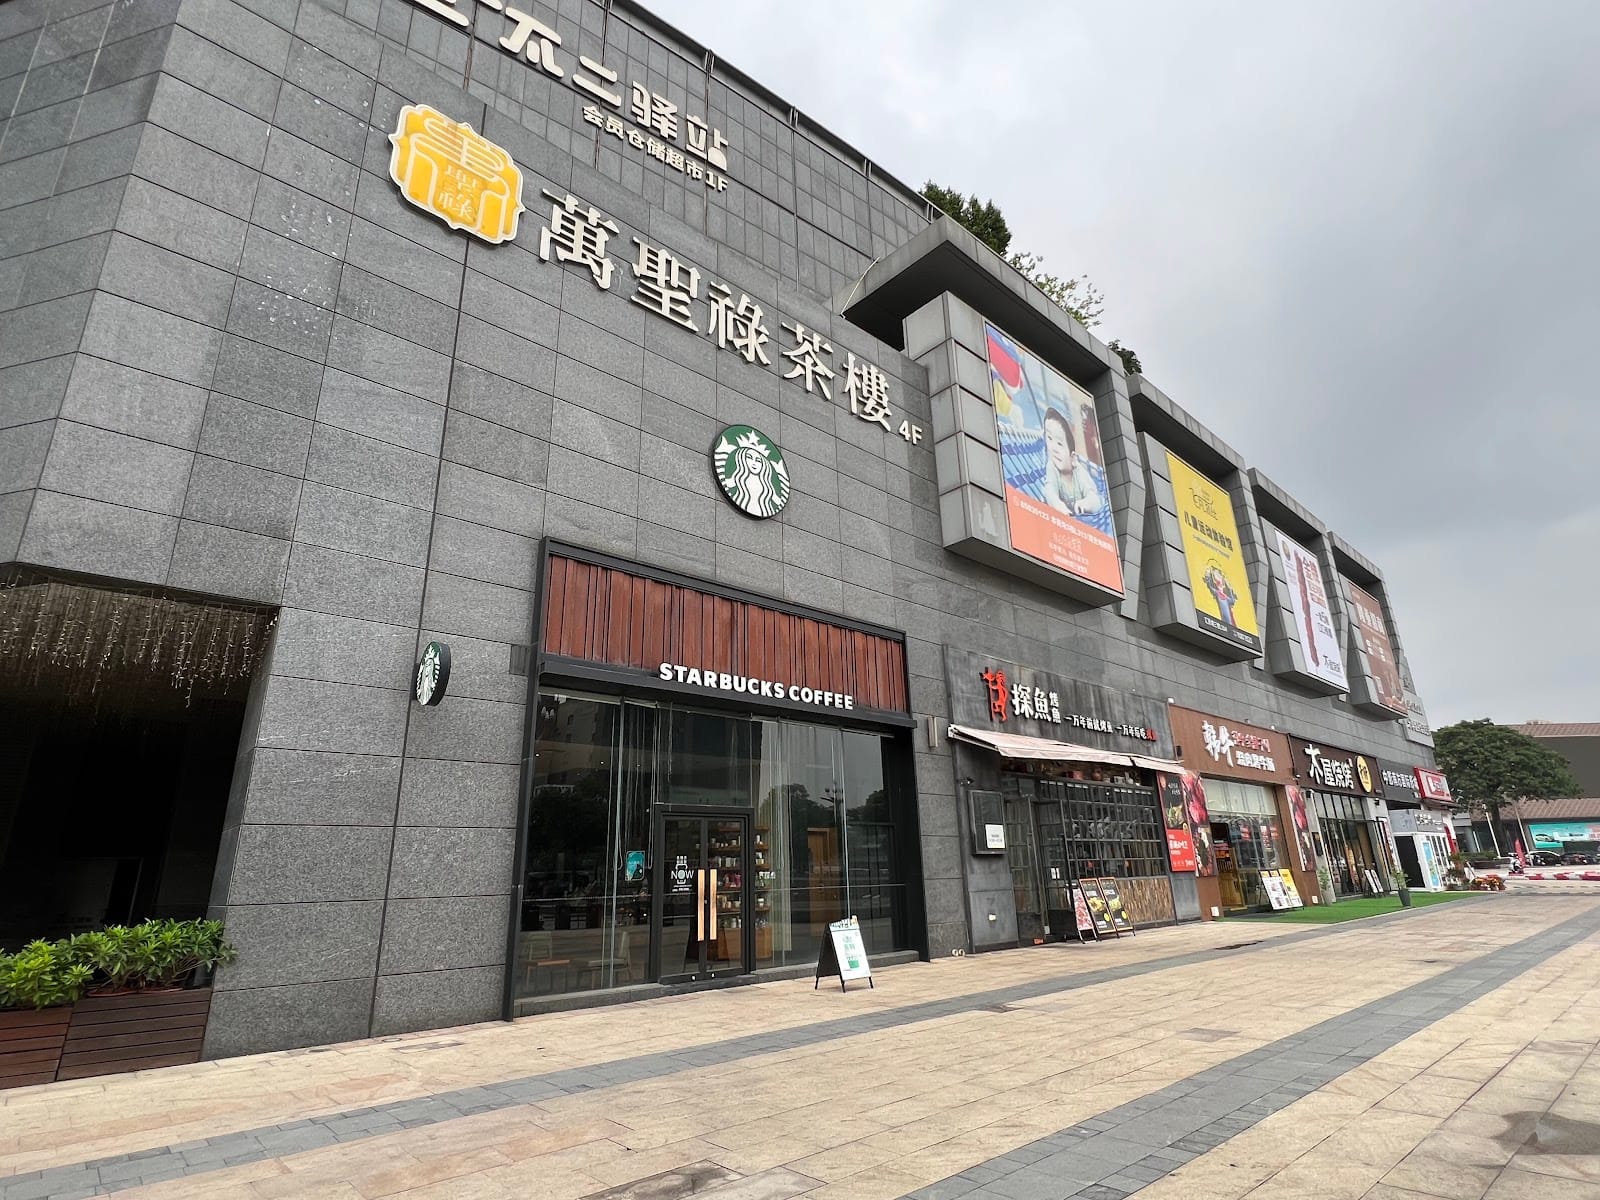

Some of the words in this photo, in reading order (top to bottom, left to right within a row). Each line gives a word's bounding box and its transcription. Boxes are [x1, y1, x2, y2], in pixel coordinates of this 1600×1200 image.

[539, 187, 893, 432] 萬聖祿茶樓
[898, 419, 923, 446] 4F
[659, 662, 785, 698] STARBUCKS
[788, 685, 854, 710] COFFEE
